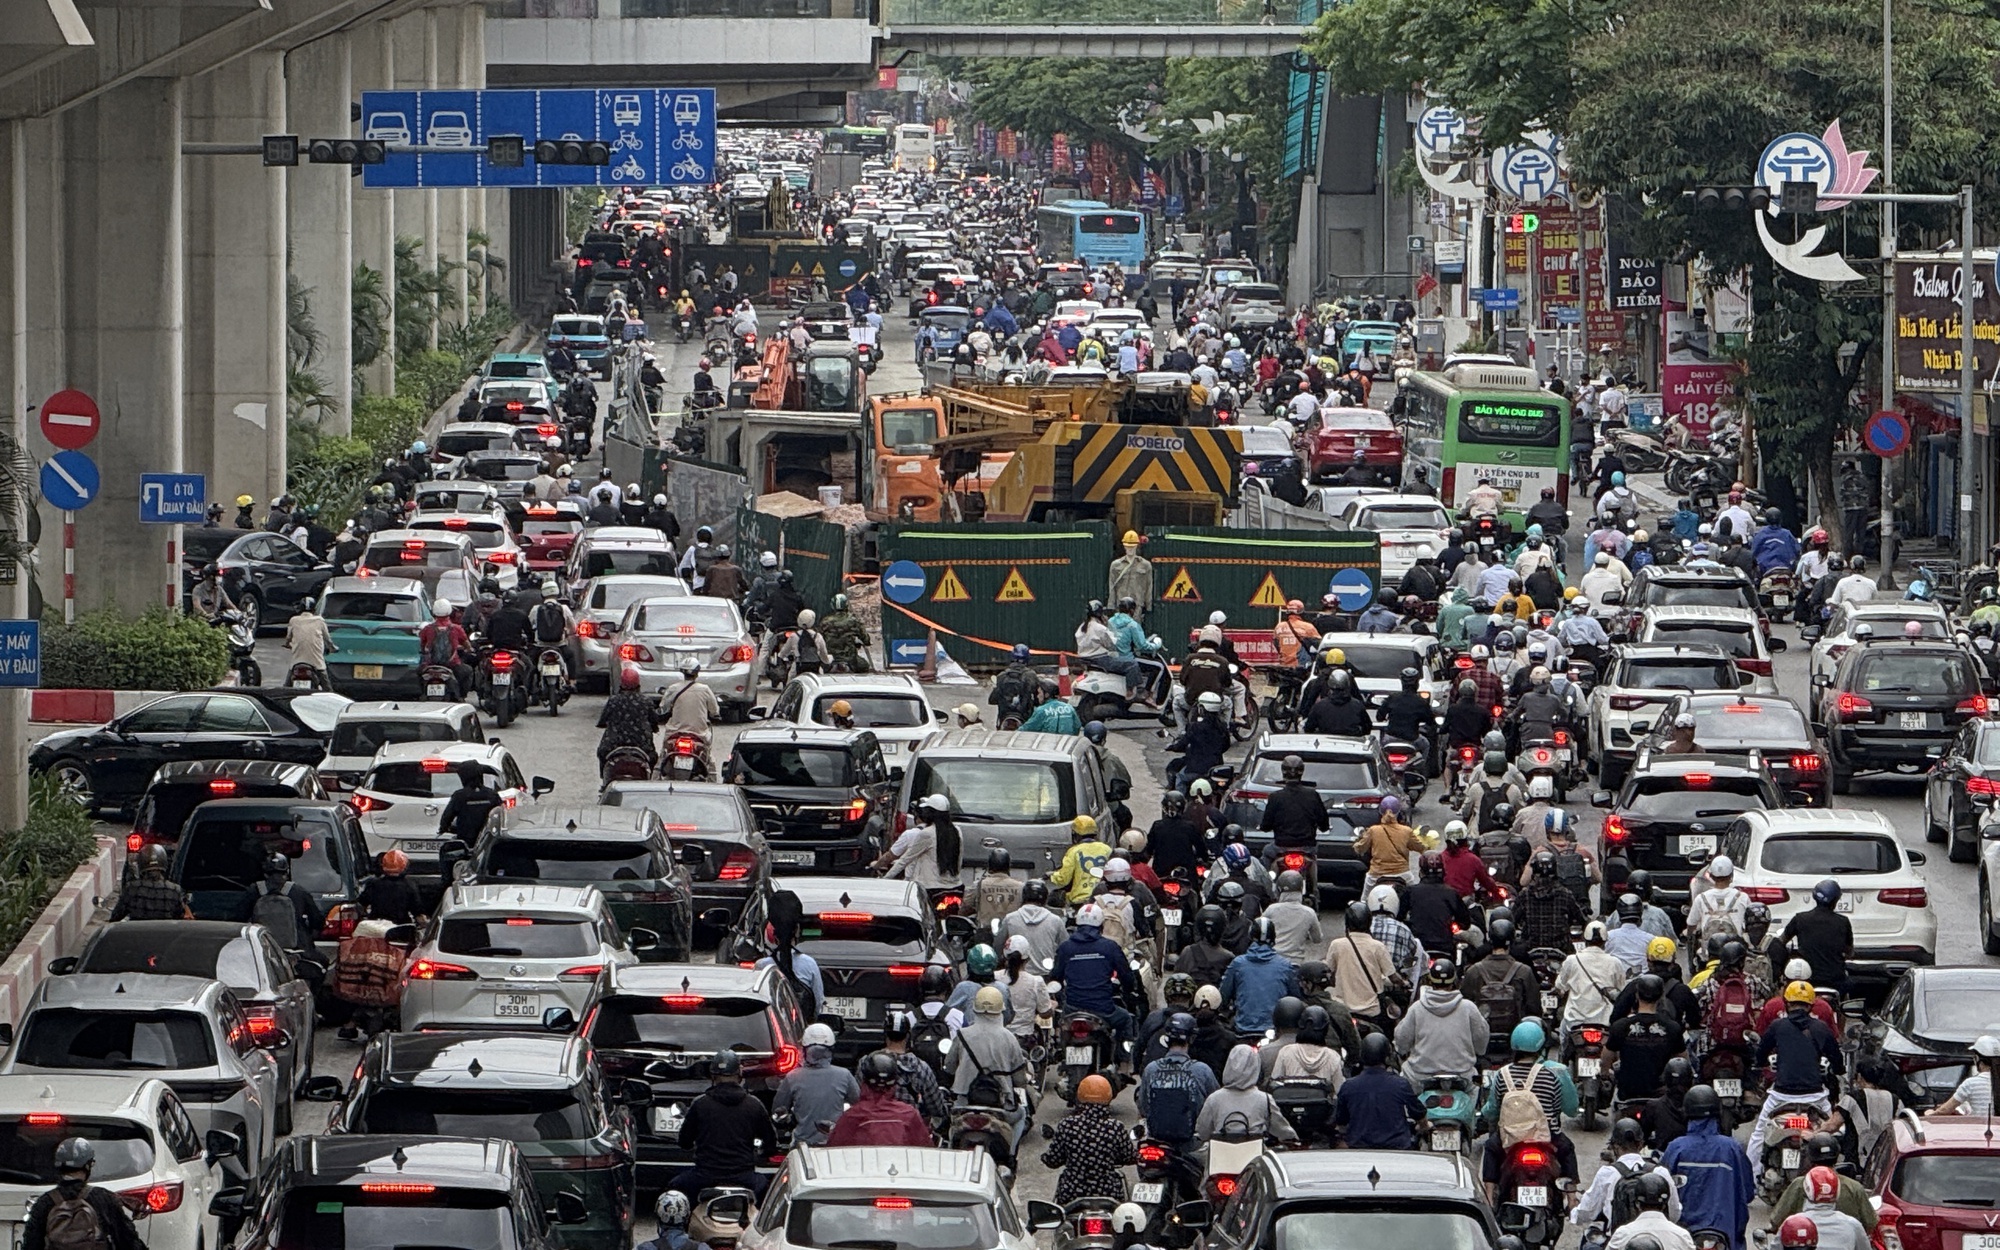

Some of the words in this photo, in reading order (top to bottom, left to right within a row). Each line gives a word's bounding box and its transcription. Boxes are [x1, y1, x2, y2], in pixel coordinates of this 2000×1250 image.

[1621, 272, 1656, 288] BẢO
[1913, 265, 1950, 297] Balon
[1616, 289, 1662, 307] HIỂM
[1900, 317, 1917, 337] Bia
[1923, 348, 1952, 375] Nhậu
[1674, 380, 1700, 395] HẢI
[1704, 379, 1734, 395] YẾN
[1128, 436, 1183, 451] KOBELCO
[174, 483, 180, 496] Ô
[182, 483, 194, 496] TÔ
[164, 502, 184, 514] QUAY
[7, 631, 31, 650] MÁY
[13, 653, 36, 674] ĐẦU
[1690, 837, 1705, 845] 51K
[508, 995, 527, 1005] 30H
[500, 1005, 535, 1015] 959.00
[660, 1120, 684, 1130] 392
